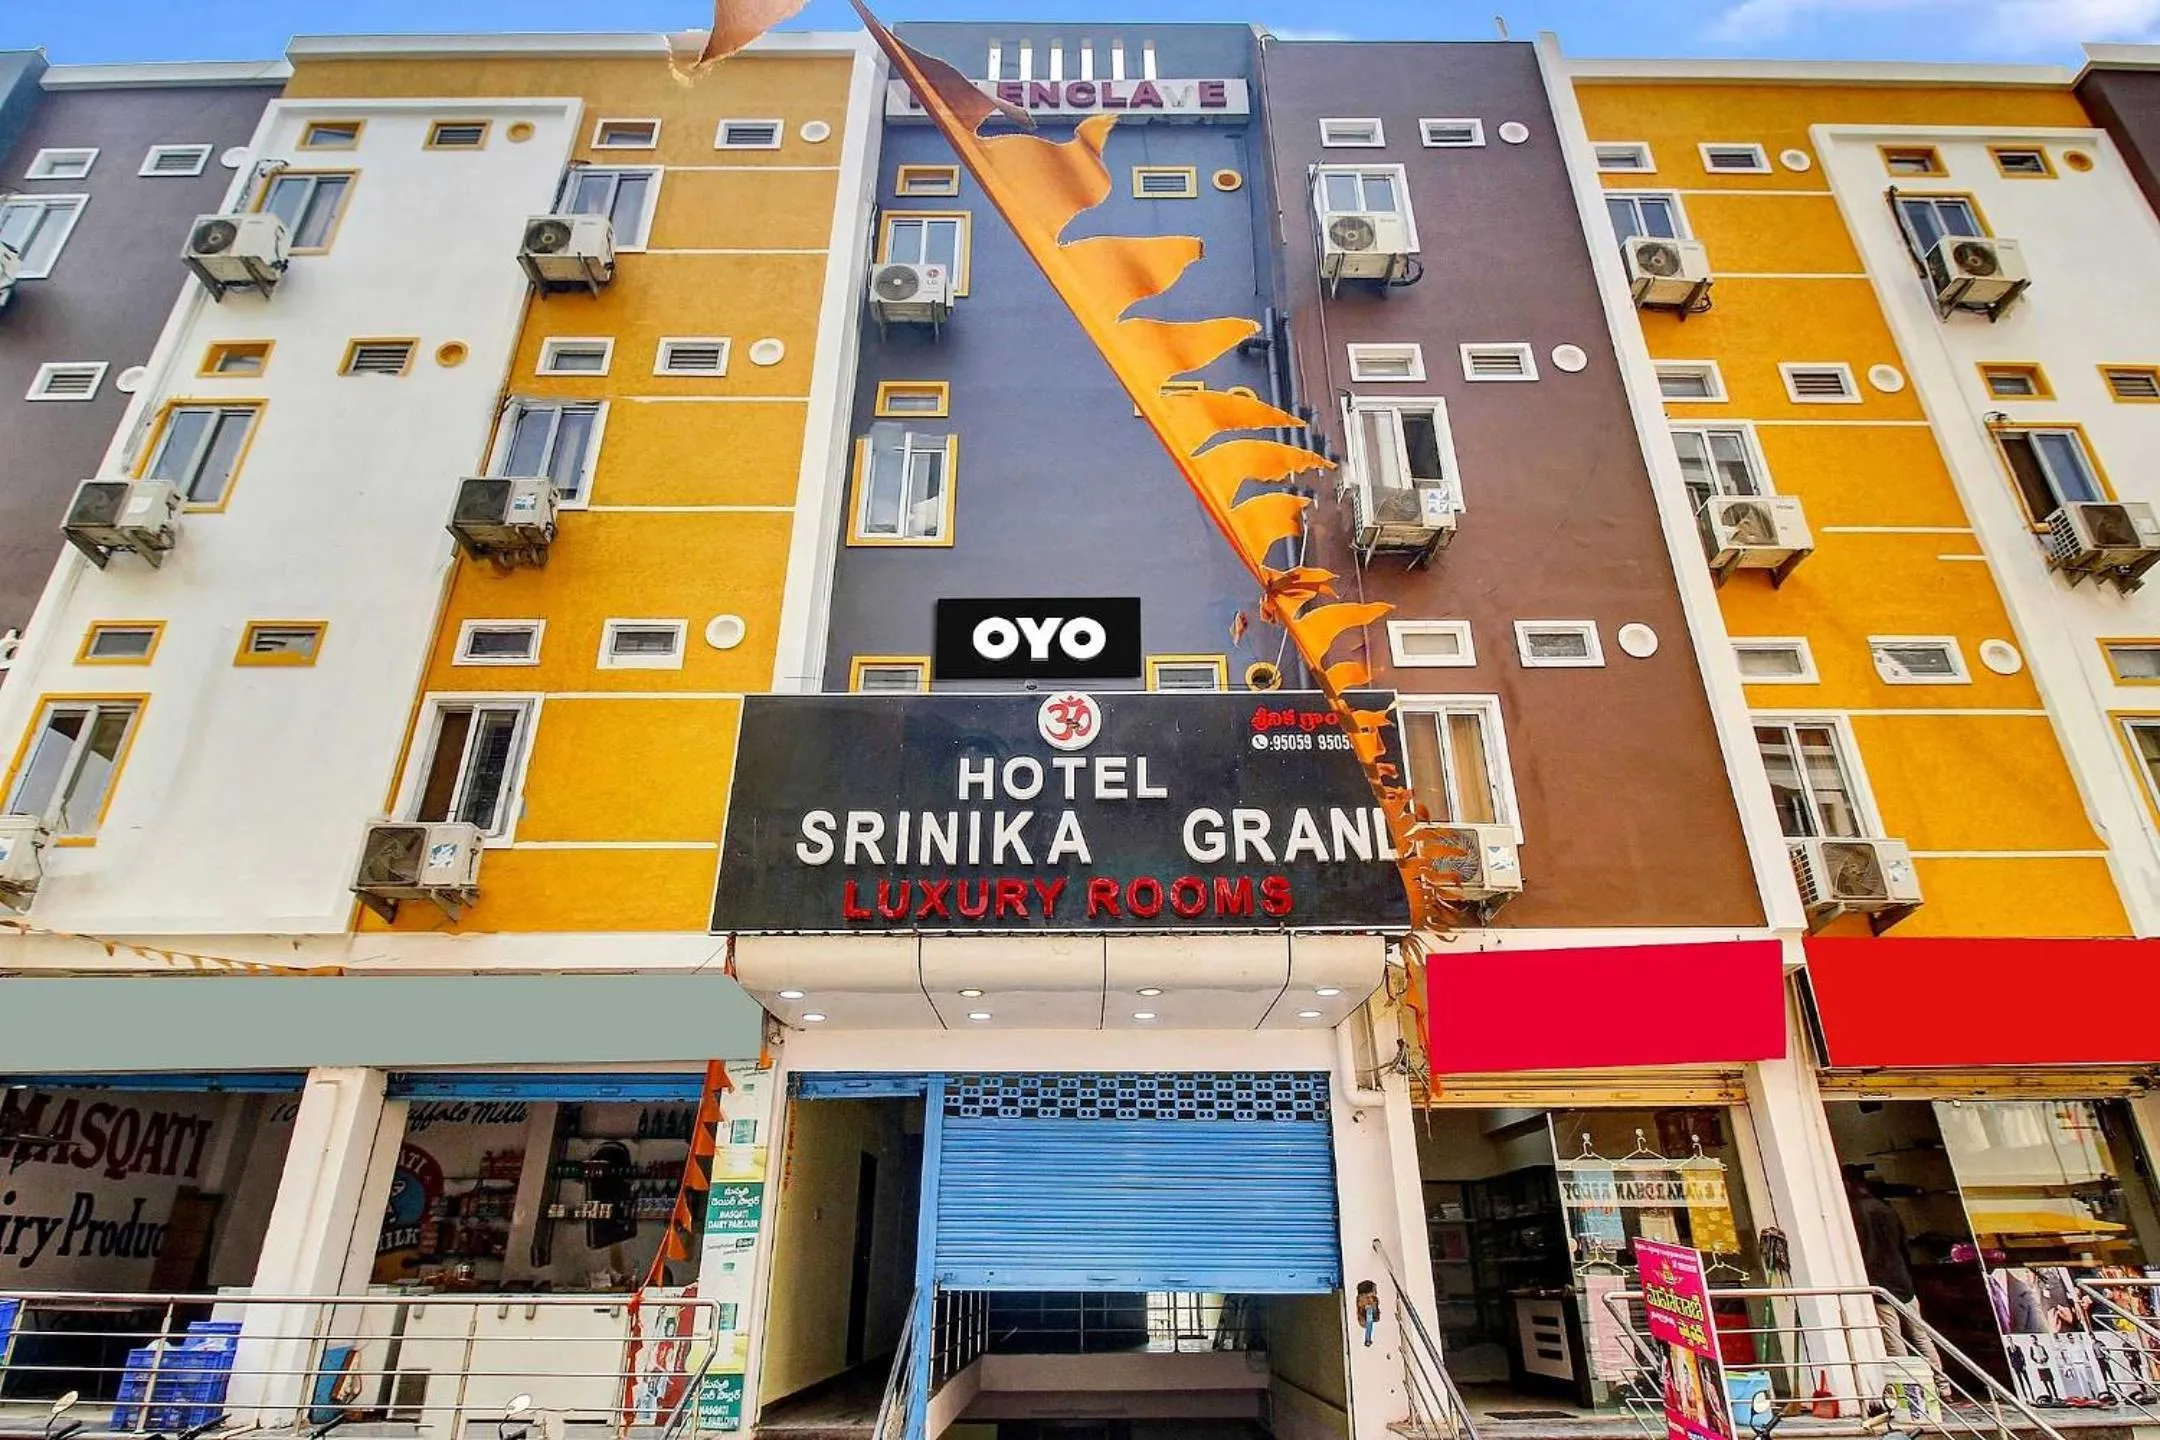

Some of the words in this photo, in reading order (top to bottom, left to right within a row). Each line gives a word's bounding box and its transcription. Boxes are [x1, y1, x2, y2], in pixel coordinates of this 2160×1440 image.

[973, 616, 1106, 661] OYO
[1317, 733, 1354, 750] 9505
[958, 756, 1168, 801] HOTEL
[796, 810, 1092, 866] SRINIKA
[842, 877, 1067, 921] LUXURY
[1087, 874, 1294, 919] ROOMS
[0, 1088, 214, 1180] MASQATI
